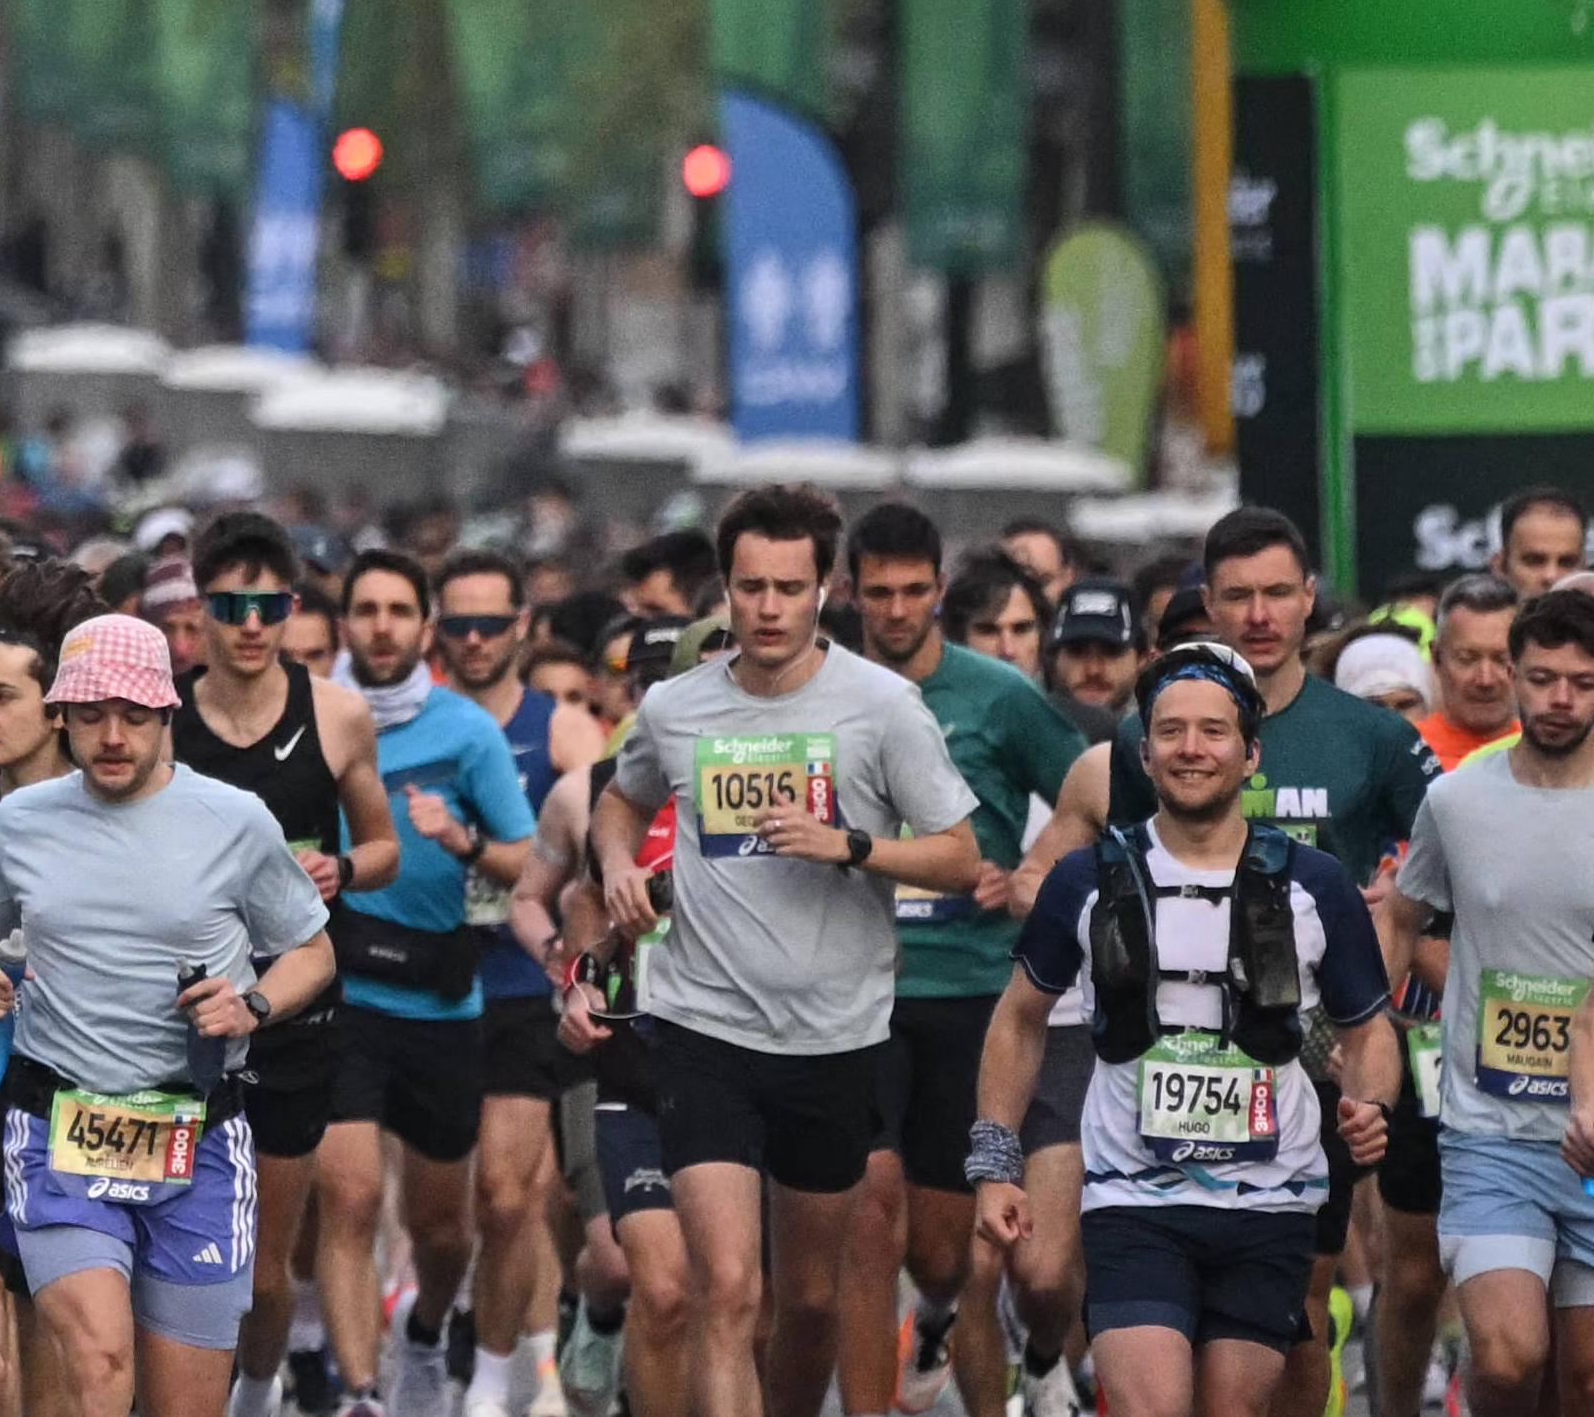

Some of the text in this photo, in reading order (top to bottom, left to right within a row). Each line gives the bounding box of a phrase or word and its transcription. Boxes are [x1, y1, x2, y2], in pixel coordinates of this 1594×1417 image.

[1405, 116, 1594, 181] Schne
[714, 738, 793, 754] Schneider
[1495, 972, 1576, 996] Schneider
[1495, 1008, 1571, 1052] 2963
[1153, 1072, 1241, 1116] 19754
[1528, 1081, 1568, 1096] asics
[67, 1110, 158, 1155] 45471
[1178, 1121, 1210, 1134] HUGO
[1194, 1146, 1235, 1160] asics
[108, 1182, 149, 1200] asics
